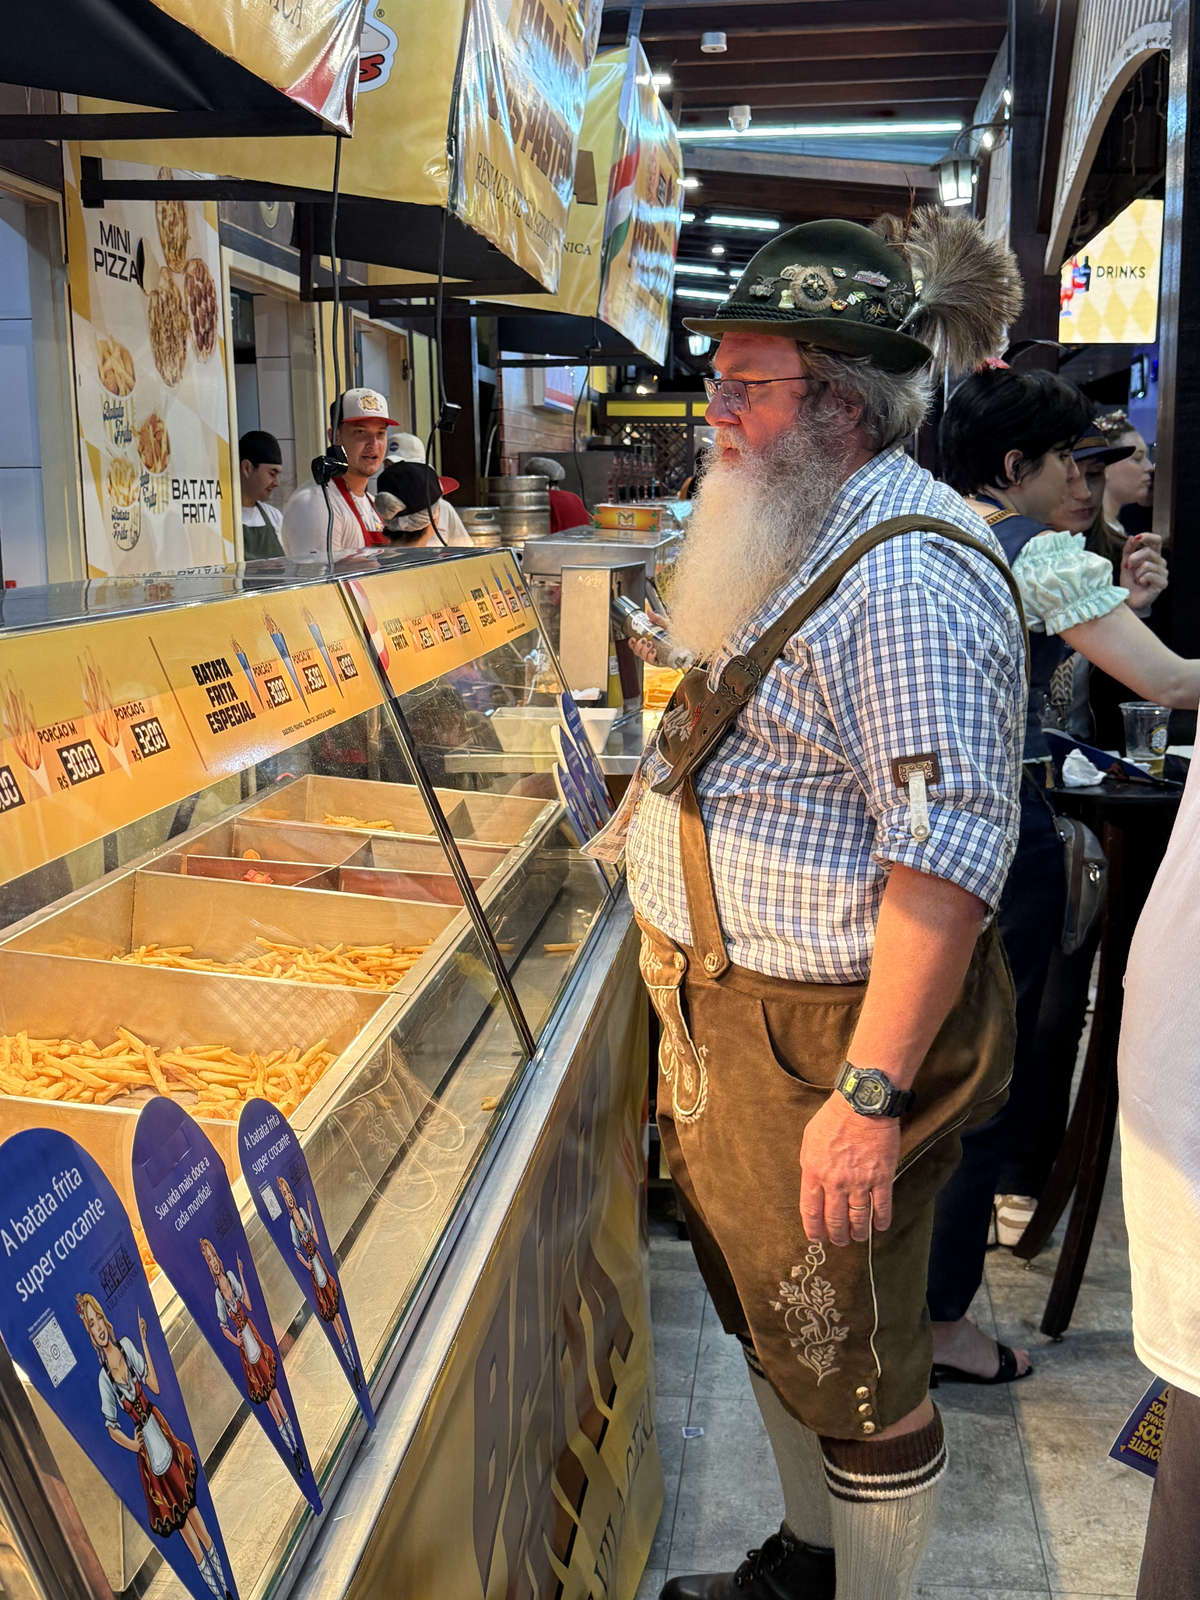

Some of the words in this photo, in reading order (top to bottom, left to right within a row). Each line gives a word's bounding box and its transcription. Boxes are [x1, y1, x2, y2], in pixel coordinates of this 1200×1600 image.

[99, 220, 131, 255] MINI
[94, 247, 140, 285] PIZZA
[1096, 265, 1146, 279] DRINKS
[171, 478, 223, 500] BATATA
[182, 503, 216, 524] FRITA
[191, 657, 233, 687] BATATA
[205, 681, 239, 708] FRITA
[113, 701, 140, 721] PORÇÃO
[205, 700, 257, 735] ESPECIAL
[37, 722, 69, 744] PORÇÃO
[67, 721, 78, 735] M
[135, 721, 167, 754] 32,00
[62, 743, 101, 781] 30,00
[131, 748, 143, 762] R$
[57, 773, 70, 791] R$
[247, 1122, 270, 1146] batata
[266, 1113, 281, 1132] frita
[243, 1135, 252, 1151] A
[251, 1153, 270, 1175] super
[267, 1133, 292, 1160] crocante
[154, 1202, 169, 1220] Sua
[166, 1188, 181, 1208] vida
[178, 1174, 194, 1196] mais
[191, 1161, 206, 1181] doce
[203, 1156, 210, 1167] a
[0, 1228, 18, 1257] A
[10, 1192, 59, 1244] batata
[51, 1167, 83, 1202] frita
[174, 1210, 190, 1231] cada
[187, 1181, 213, 1217] mordida!
[16, 1249, 56, 1302] super
[54, 1198, 105, 1260] crocante
[1134, 1421, 1164, 1446] COS
[1128, 1437, 1161, 1460] OVEITE
